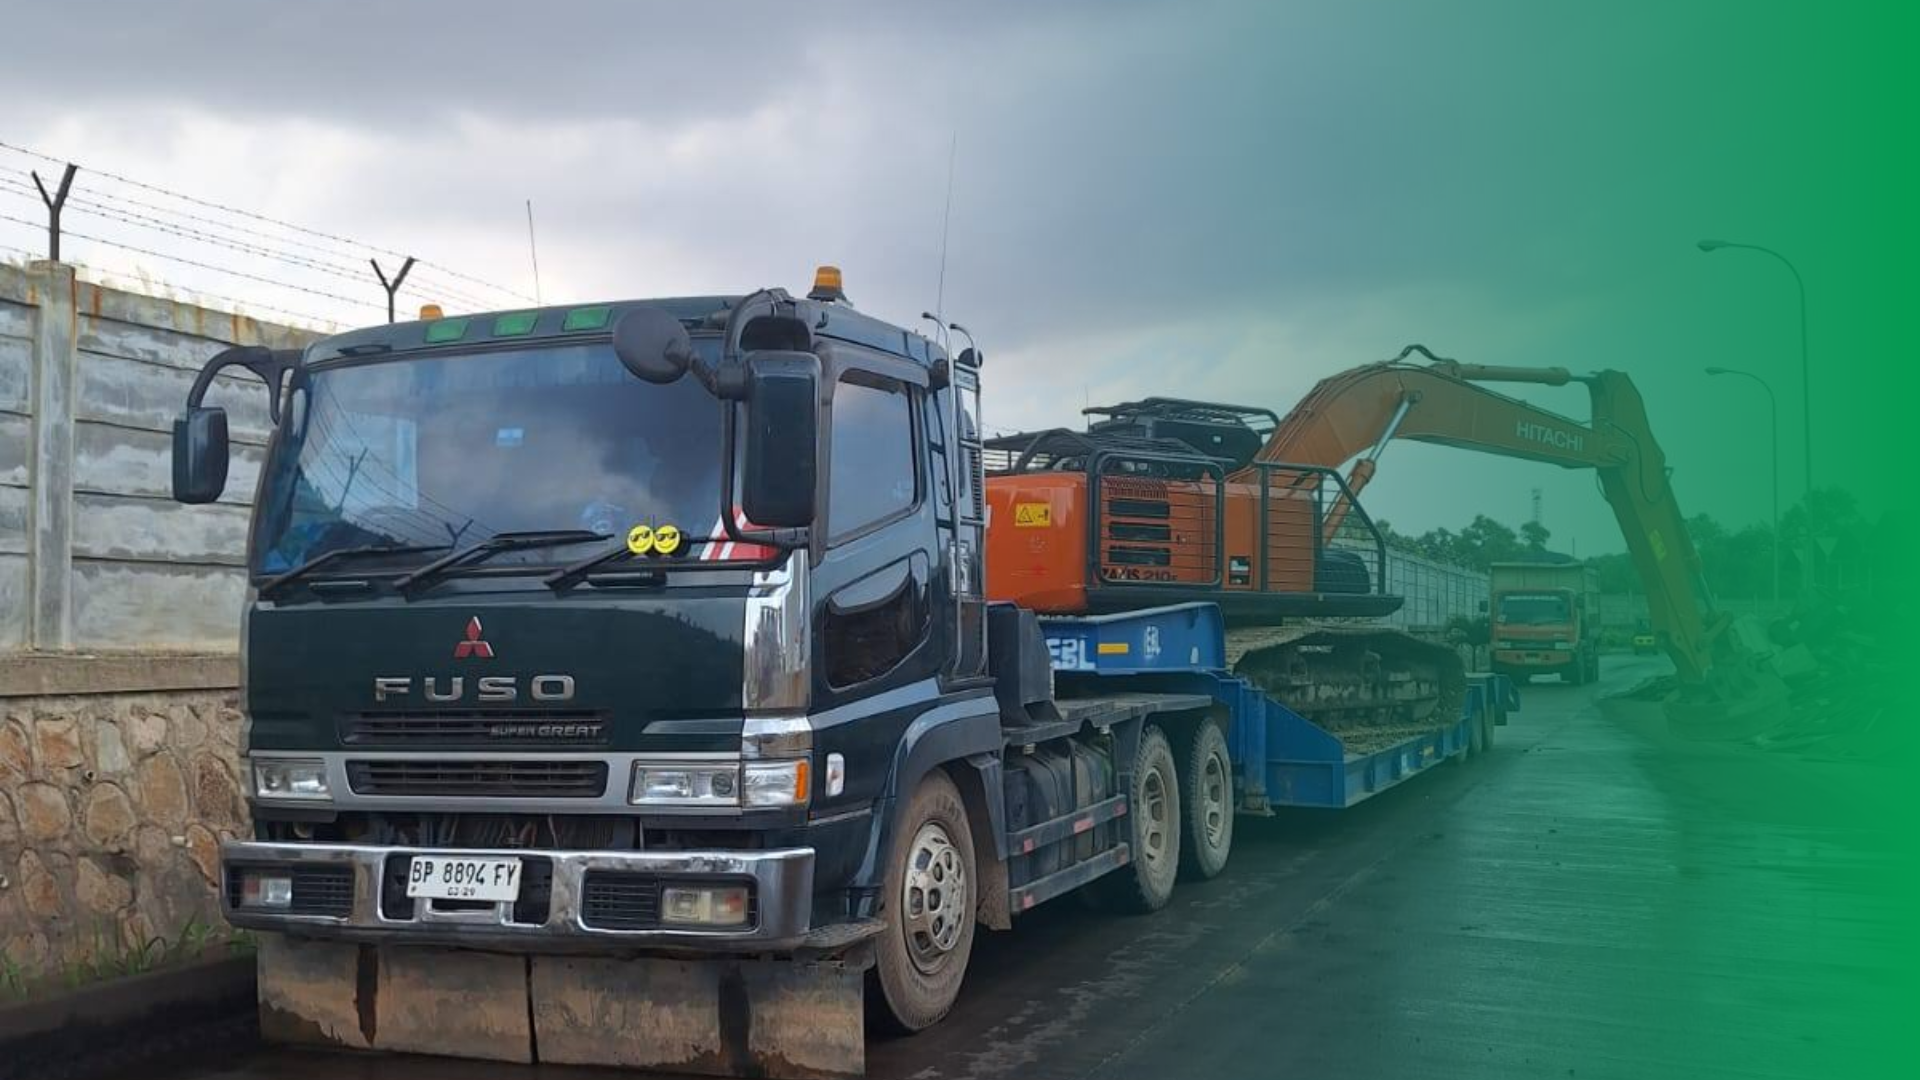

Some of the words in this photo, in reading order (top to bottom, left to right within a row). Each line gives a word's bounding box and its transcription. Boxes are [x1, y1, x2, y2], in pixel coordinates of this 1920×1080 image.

[1516, 421, 1583, 451] HITACHI
[375, 675, 575, 701] FUSO
[490, 725, 535, 736] SUPER
[537, 725, 602, 736] GREAT
[412, 861, 434, 883] BP
[443, 862, 486, 885] 8894
[494, 864, 517, 886] FY
